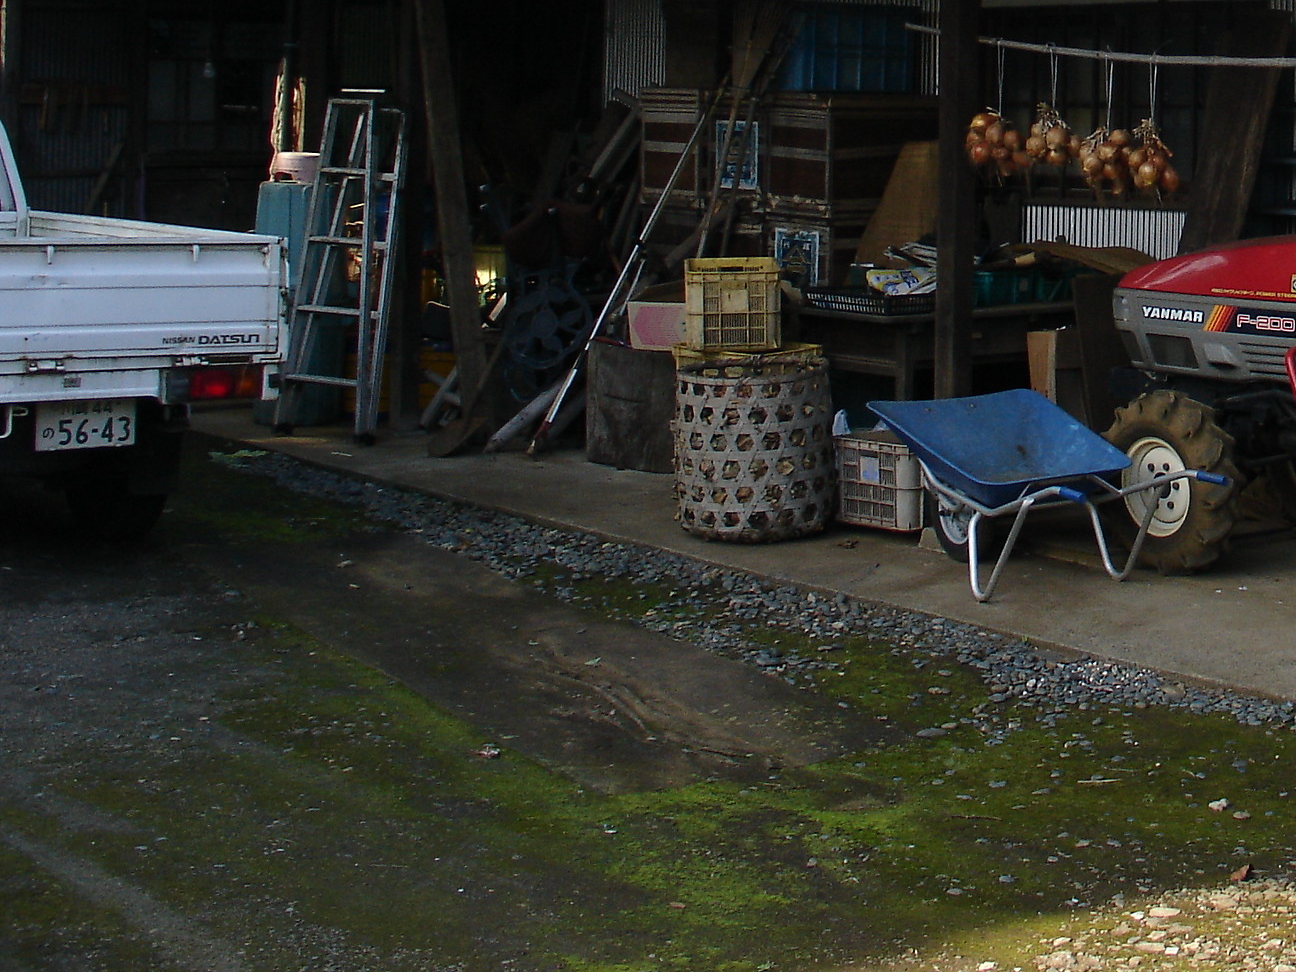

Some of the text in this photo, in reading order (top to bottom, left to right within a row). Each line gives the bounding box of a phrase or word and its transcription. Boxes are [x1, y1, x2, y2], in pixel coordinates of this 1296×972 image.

[1142, 306, 1296, 333] YANMAR F-200
[162, 334, 260, 345] NISSAN DATSUN
[42, 416, 131, 446] の 56-43
